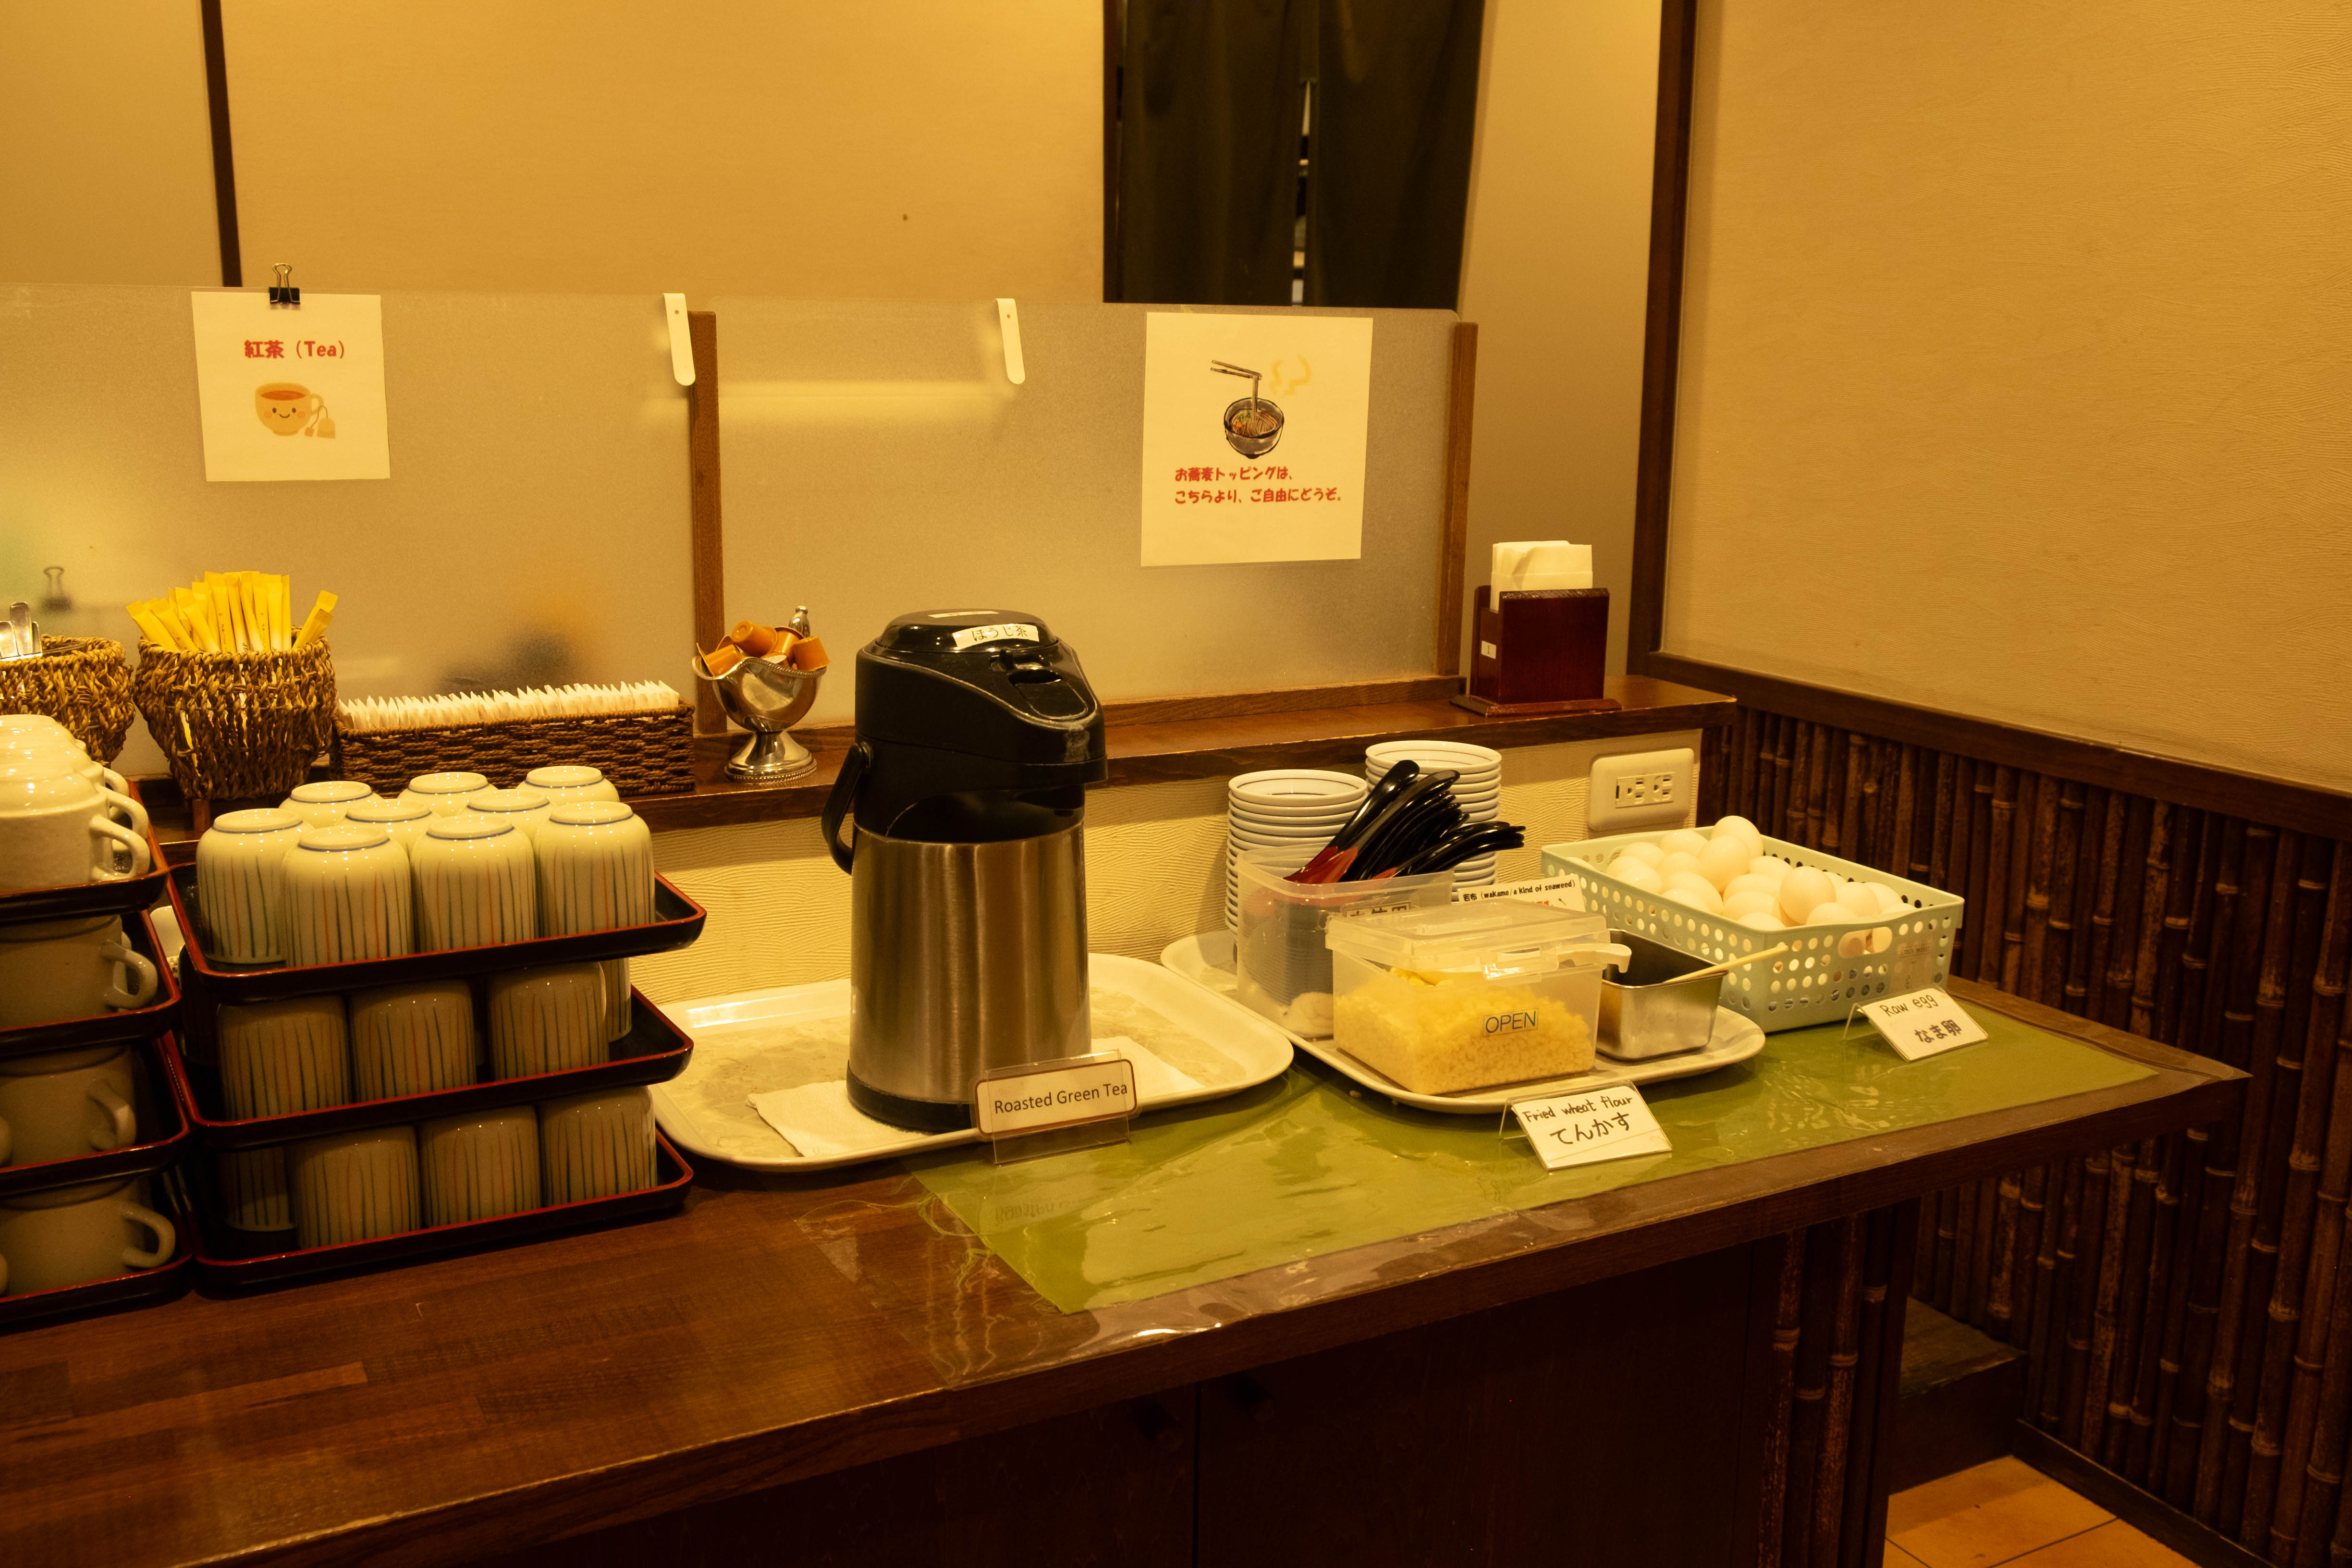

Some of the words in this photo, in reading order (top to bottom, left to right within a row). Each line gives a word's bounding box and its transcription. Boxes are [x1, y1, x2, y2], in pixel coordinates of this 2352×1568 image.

[972, 625, 1028, 642] ほうじ茶
[1519, 886, 1532, 894] kind
[1544, 880, 1575, 891] seaweed)
[1879, 1002, 1909, 1017] Raw
[1912, 994, 1939, 1008] egg
[1485, 1011, 1536, 1033] OPEN
[1914, 1019, 1963, 1043] なま卵
[994, 1092, 1053, 1114] Roasted
[1056, 1087, 1100, 1104] Green
[1103, 1083, 1127, 1097] Tea
[1522, 1106, 1556, 1123] Fried
[1561, 1099, 1597, 1115] wheat
[1601, 1095, 1633, 1109] flour
[1549, 1112, 1629, 1145] てんかす
